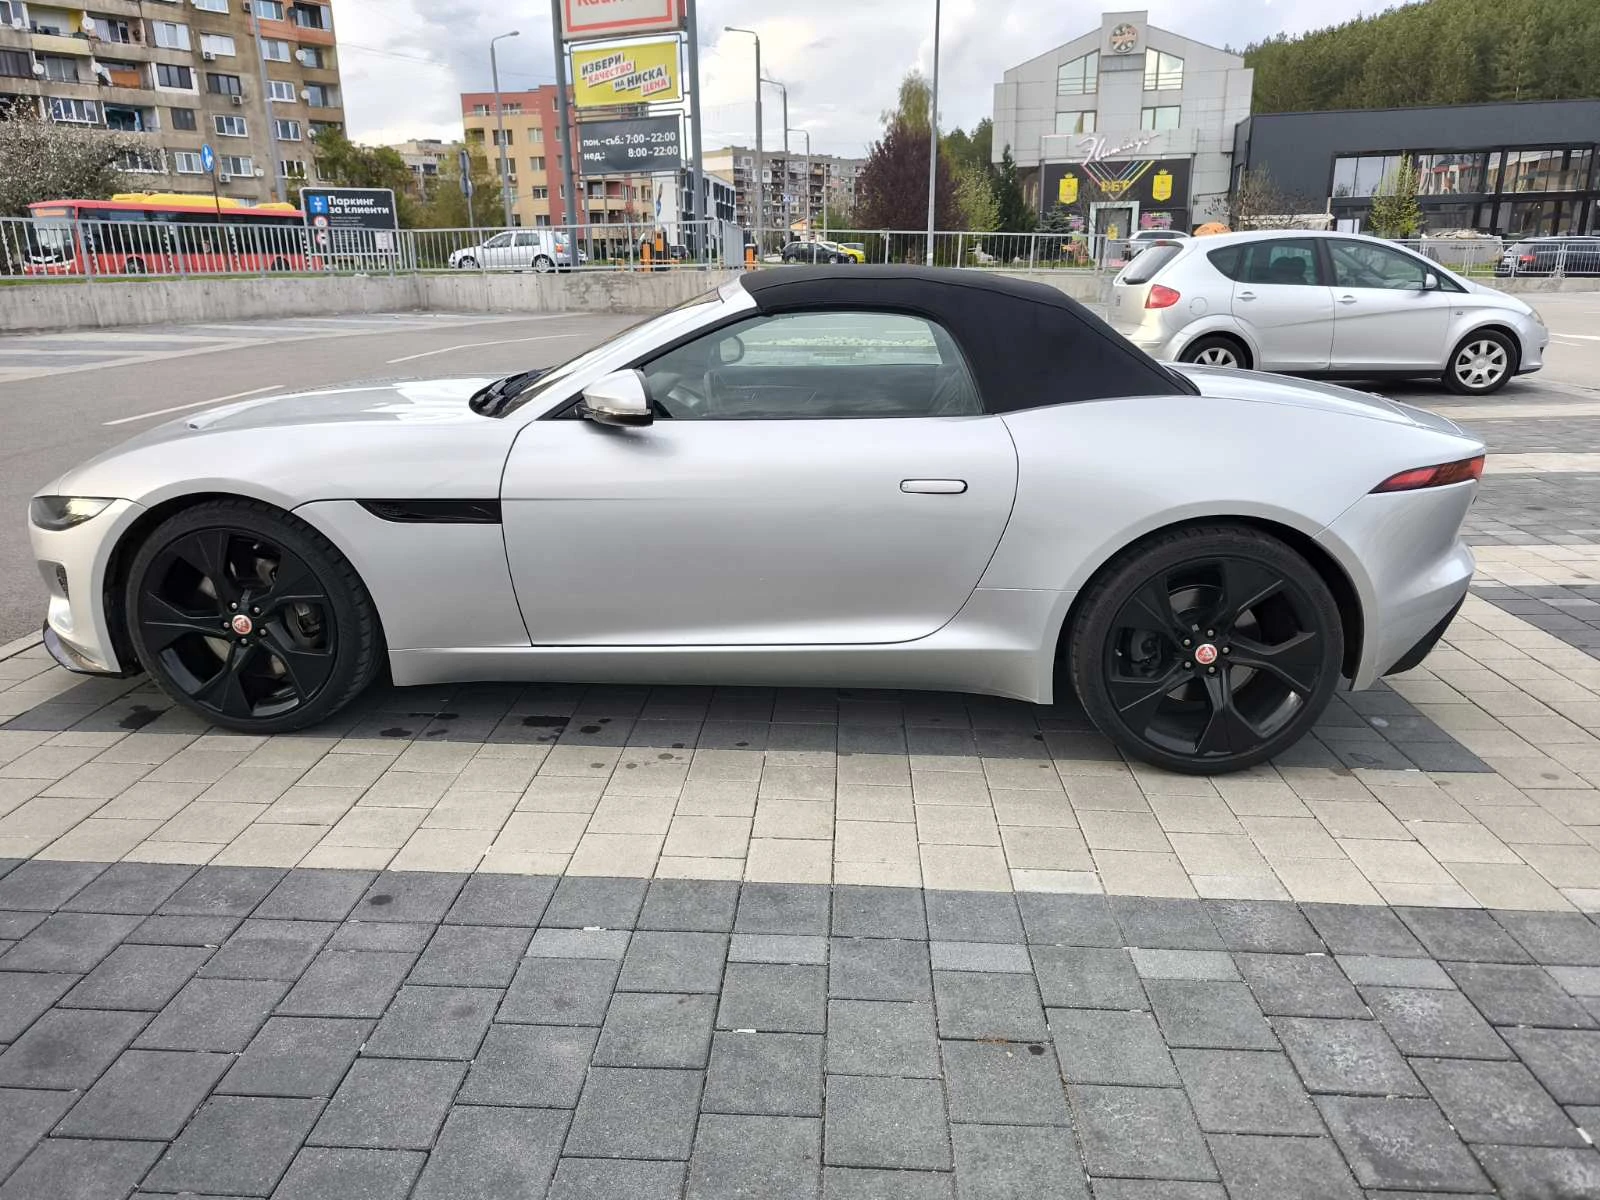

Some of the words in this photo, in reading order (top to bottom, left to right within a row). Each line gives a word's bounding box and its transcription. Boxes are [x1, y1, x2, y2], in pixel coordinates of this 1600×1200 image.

[582, 54, 622, 75] ИЗБЕРИ
[588, 63, 632, 82] КАЧЕСТВО
[614, 80, 625, 89] НА
[627, 67, 663, 87] НИСКА
[643, 79, 667, 93] ЦЕНА
[328, 195, 374, 207] Паркинг
[329, 206, 342, 214] за
[344, 206, 389, 214] клиенти
